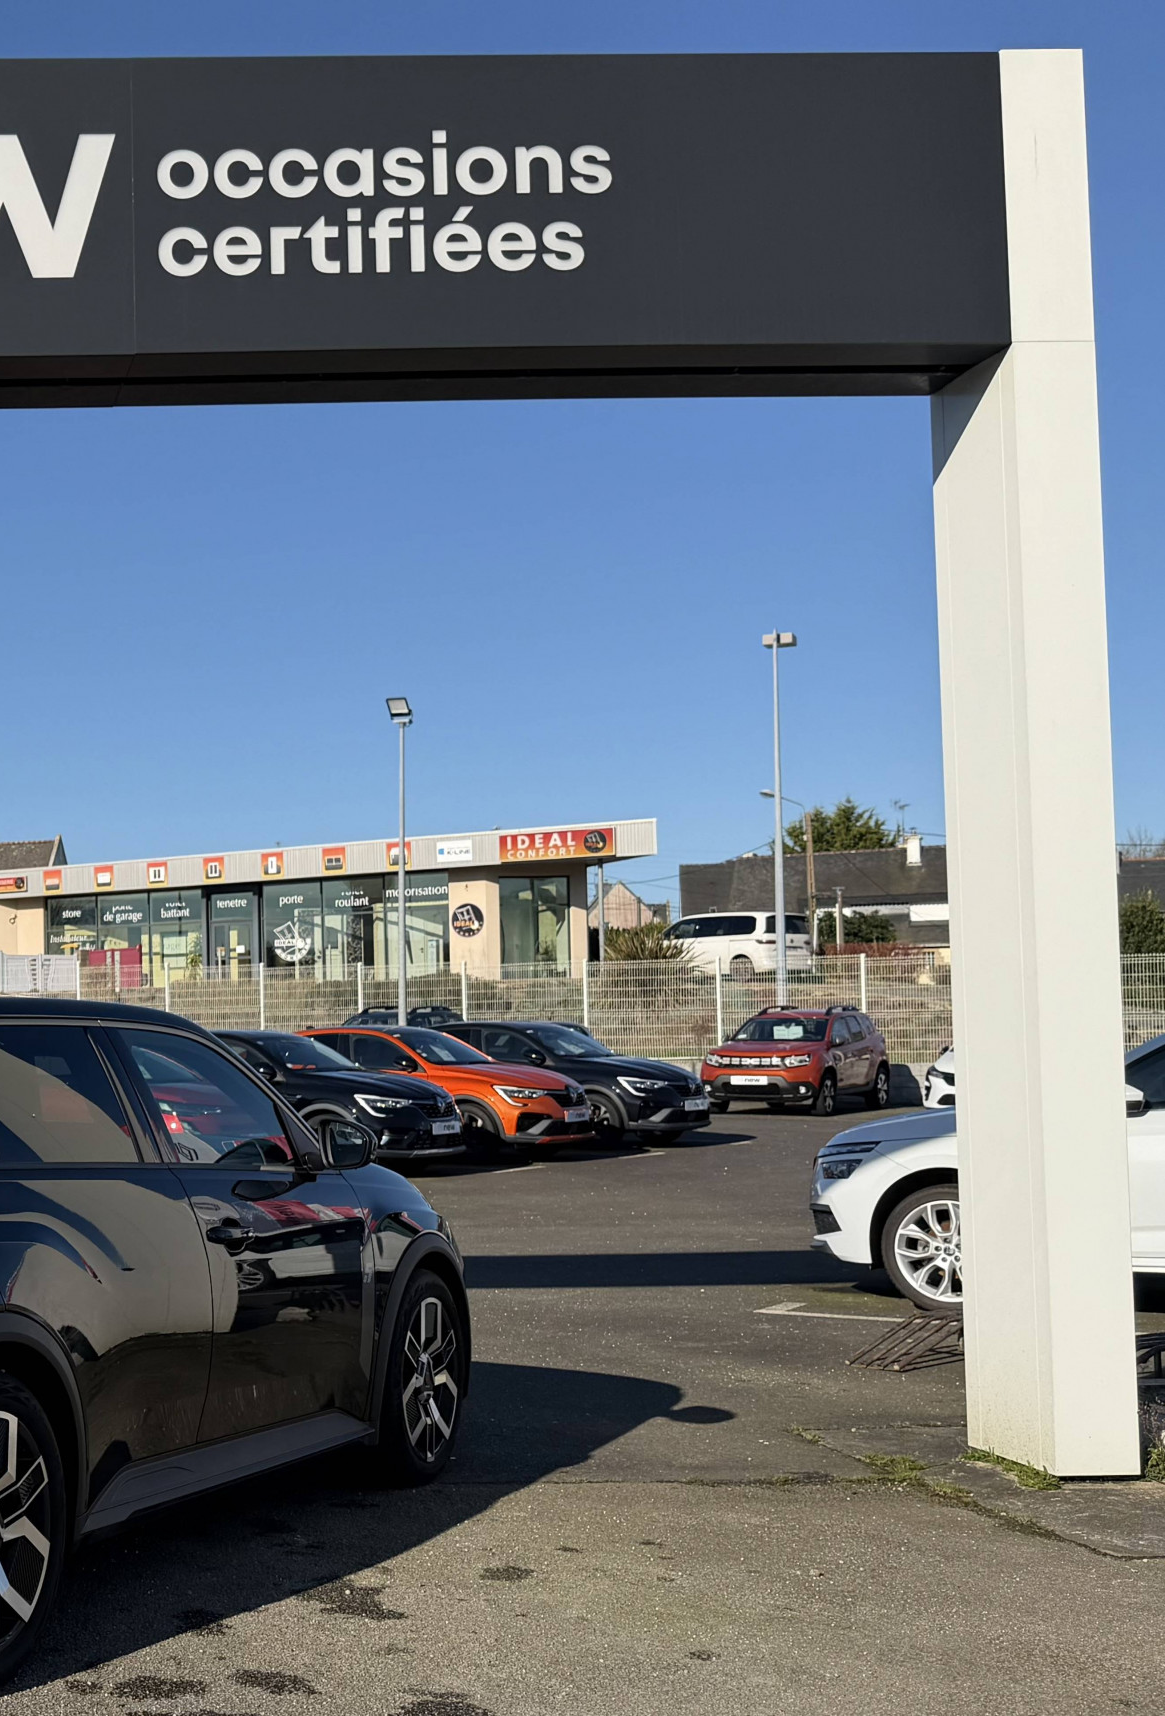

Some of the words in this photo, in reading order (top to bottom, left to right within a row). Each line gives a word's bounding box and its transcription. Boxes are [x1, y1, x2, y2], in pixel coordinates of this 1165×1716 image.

[157, 130, 613, 200] occasions
[157, 205, 585, 277] certifiées
[507, 831, 576, 850] IDEAL
[507, 846, 575, 859] CONFORT
[385, 885, 448, 898] moorisation
[279, 895, 304, 908] porte
[334, 896, 369, 907] roulant
[62, 909, 82, 919] store
[103, 911, 114, 922] de
[115, 912, 143, 924] garage
[160, 908, 190, 919] battant
